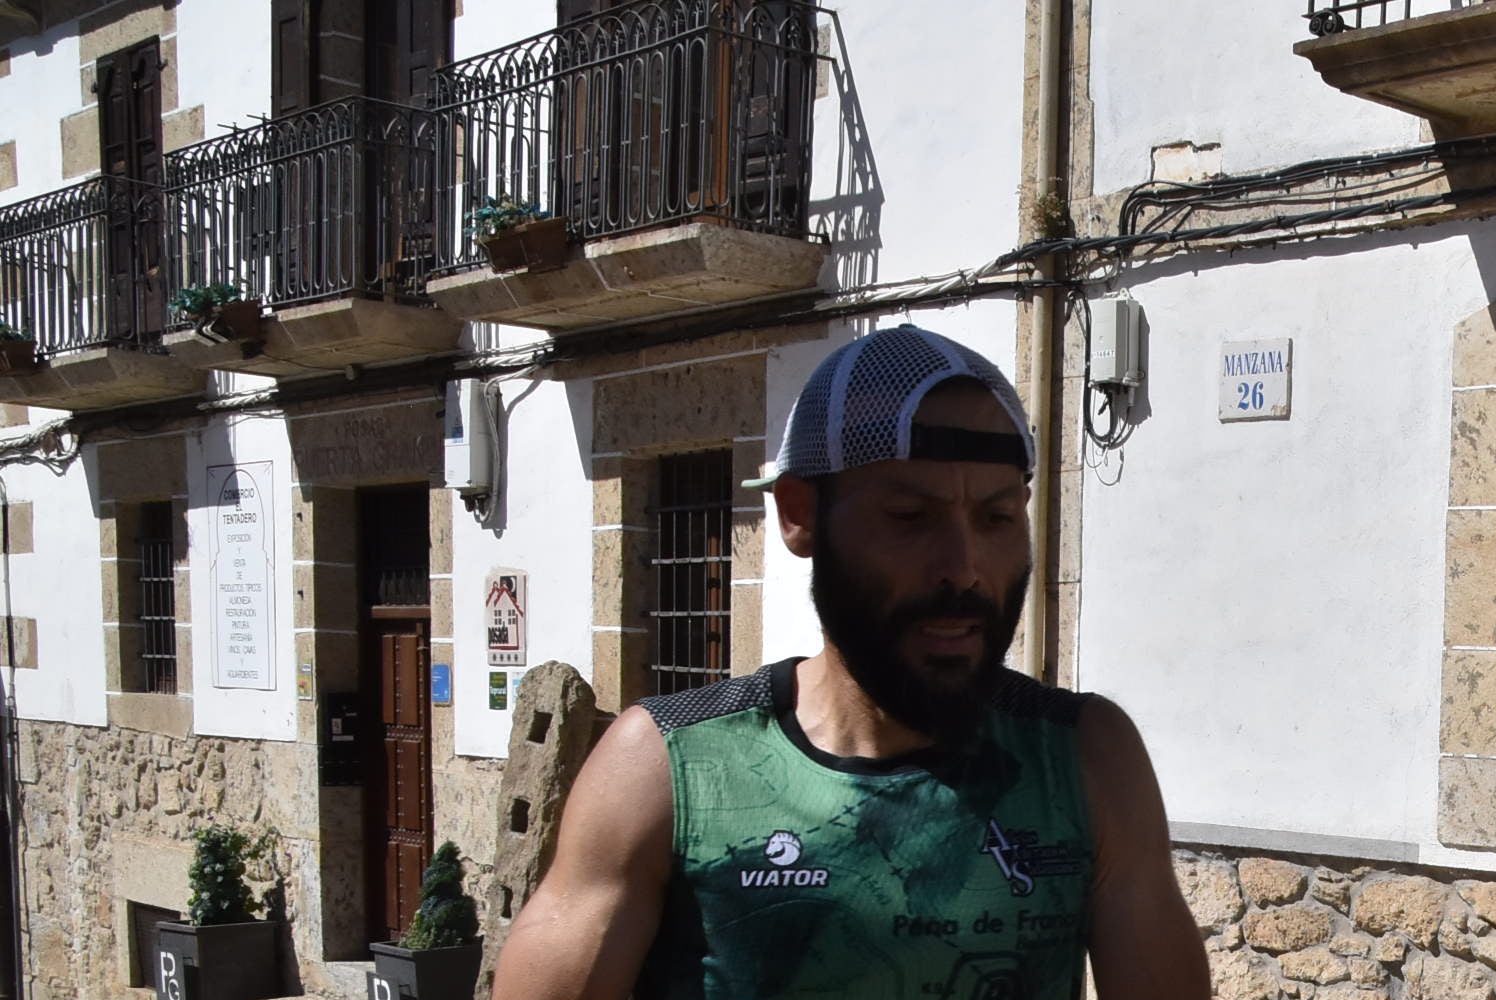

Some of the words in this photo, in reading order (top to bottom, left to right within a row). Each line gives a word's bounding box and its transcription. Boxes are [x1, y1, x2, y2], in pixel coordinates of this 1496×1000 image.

[1223, 351, 1284, 377] MANZANA
[1237, 381, 1265, 410] 26
[223, 488, 255, 501] COMERCIO
[235, 502, 243, 512] EL
[223, 513, 257, 525] TENTADERO
[740, 869, 829, 888] VIATOR
[973, 910, 1004, 935] de
